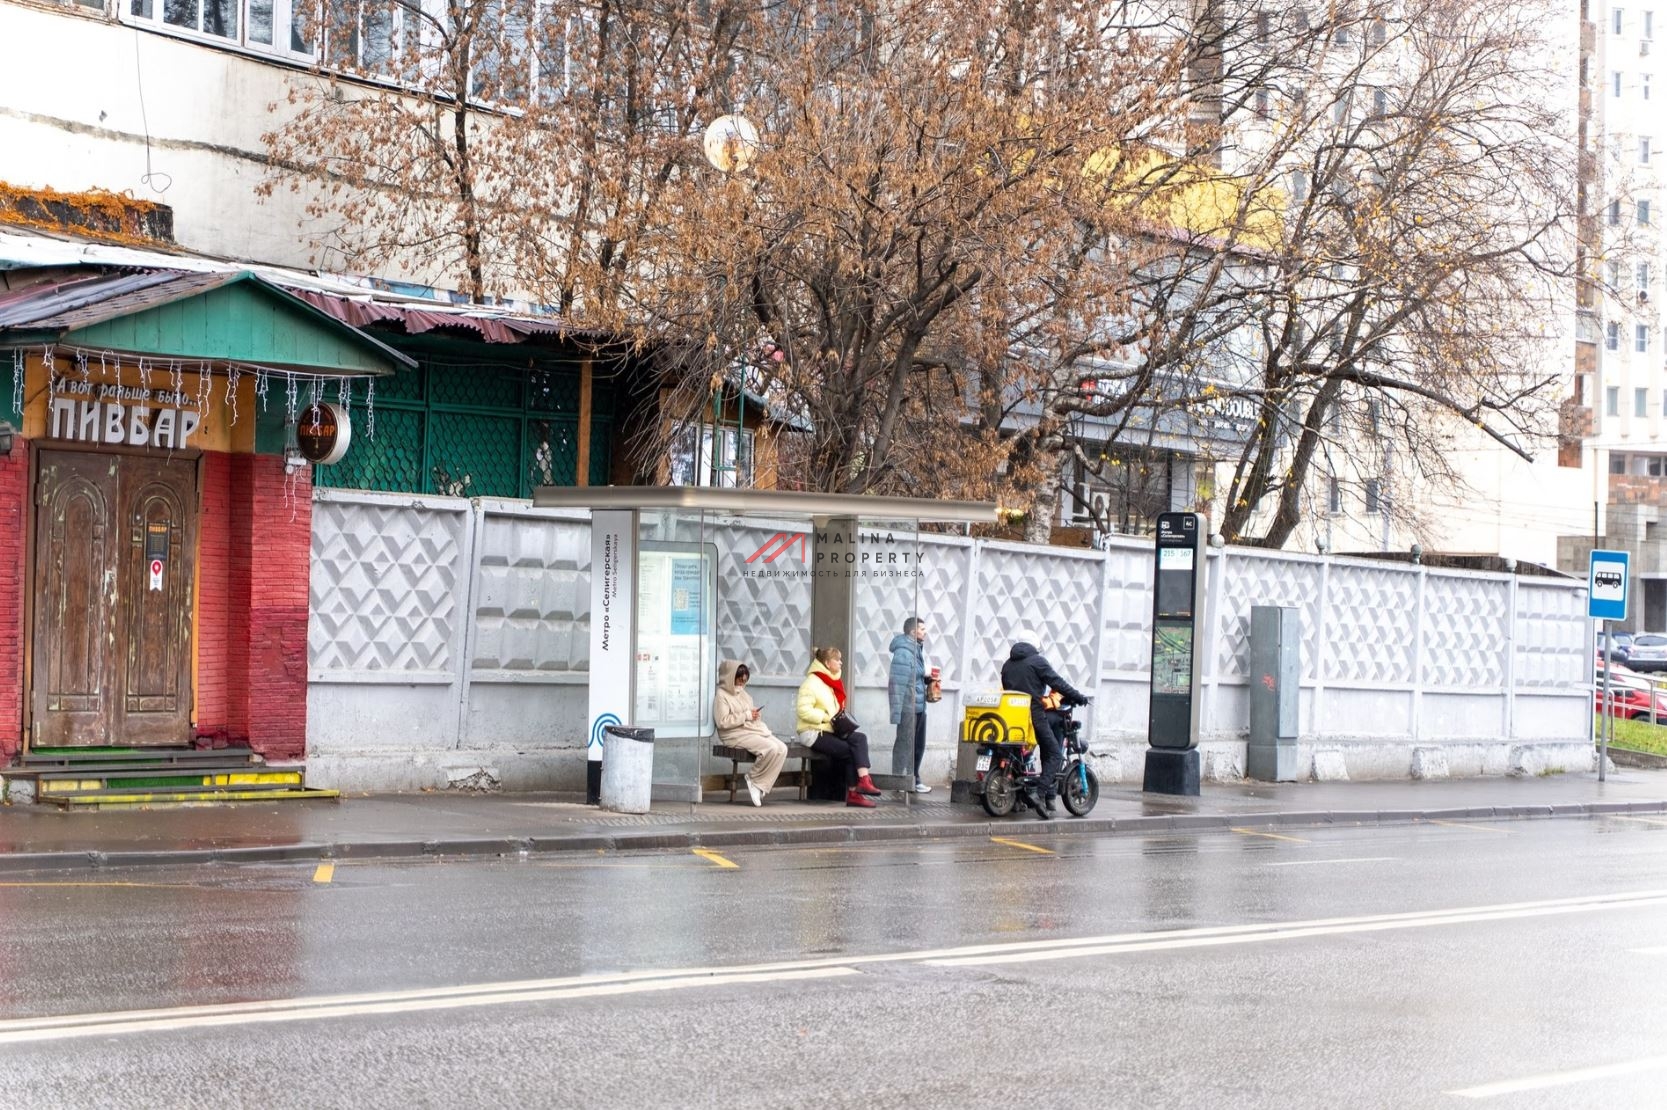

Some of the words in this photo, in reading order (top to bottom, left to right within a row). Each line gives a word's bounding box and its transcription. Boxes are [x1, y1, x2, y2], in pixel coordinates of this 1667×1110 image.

[57, 377, 66, 393] А
[70, 381, 93, 395] вот
[100, 383, 150, 401] раньше
[52, 397, 200, 449] ПИВБАР
[602, 614, 611, 651] Метро
